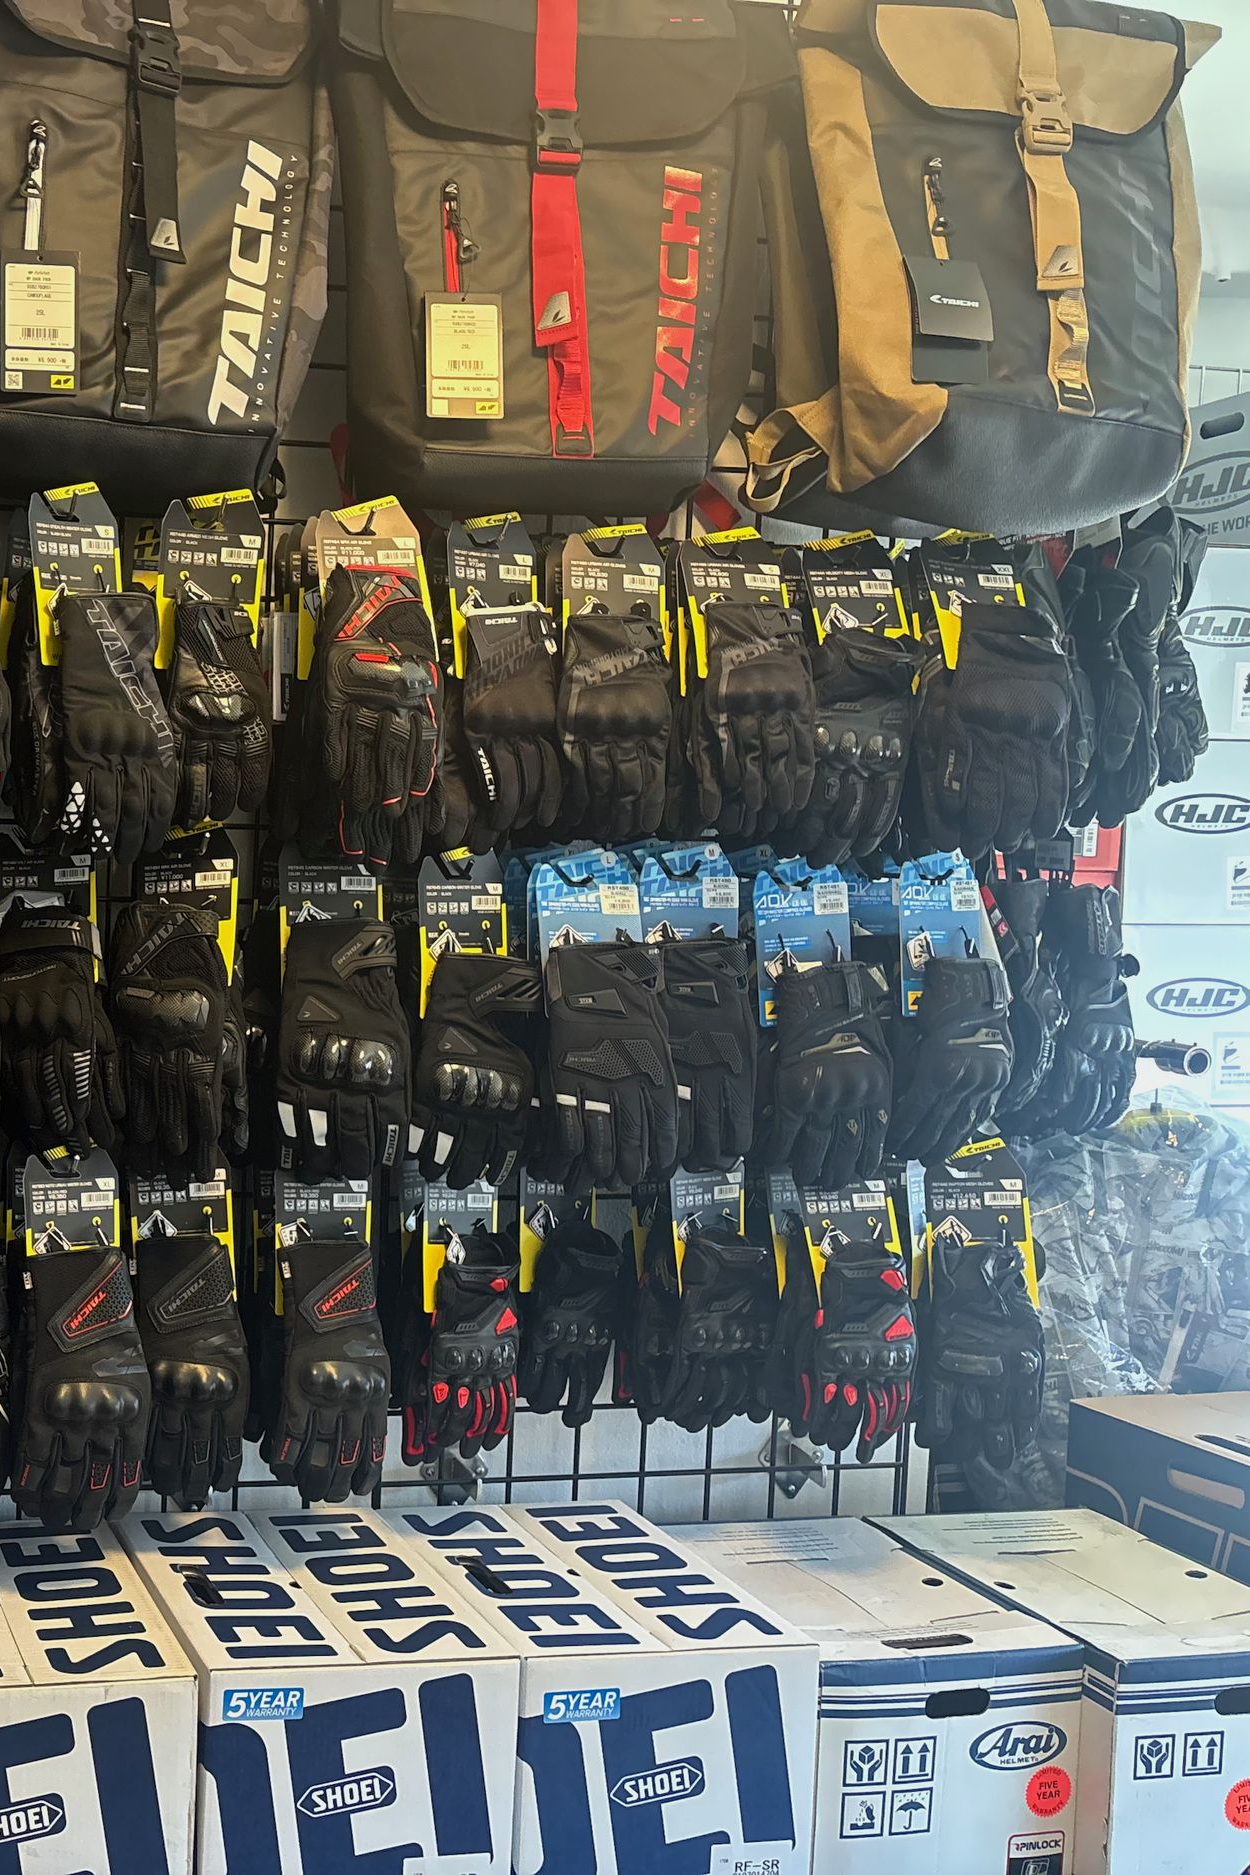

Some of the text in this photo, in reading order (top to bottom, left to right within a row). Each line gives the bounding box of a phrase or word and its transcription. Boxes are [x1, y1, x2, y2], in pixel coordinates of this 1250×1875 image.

[207, 139, 283, 426] TAICHI
[248, 154, 298, 433] INNOVATIVE TECHNOLOGY
[647, 165, 703, 436] TAICHI
[941, 297, 980, 308] TAICHI
[847, 533, 872, 543] TAICHI
[478, 748, 496, 802] TAICHI
[1169, 804, 1250, 824] HJC
[755, 893, 793, 909] ADV
[1160, 988, 1240, 1007] HJC
[384, 1127, 398, 1166] TAICHI
[973, 1142, 1001, 1153] TAICHI
[322, 1279, 359, 1313] TAICHI
[70, 1291, 106, 1330] TAICHI
[269, 1513, 486, 1653] SHOEI
[401, 1511, 640, 1648] SHOEI
[525, 1505, 784, 1639] SHOEI
[141, 1517, 341, 1659] SHOEI
[246, 1706, 296, 1717] WARRANTY
[565, 1706, 614, 1718] WARRANTY
[977, 1727, 1056, 1758] Arai
[1000, 1756, 1035, 1765] HELMET
[311, 1778, 382, 1814] SHOEI
[624, 1765, 690, 1803] SHOEI
[1036, 1790, 1060, 1800] YEAR
[1039, 1781, 1058, 1790] FIVE
[1032, 1801, 1064, 1815] WARRANTY
[1020, 1839, 1061, 1851] PINLOCK
[734, 1859, 780, 1873] RF-SR
